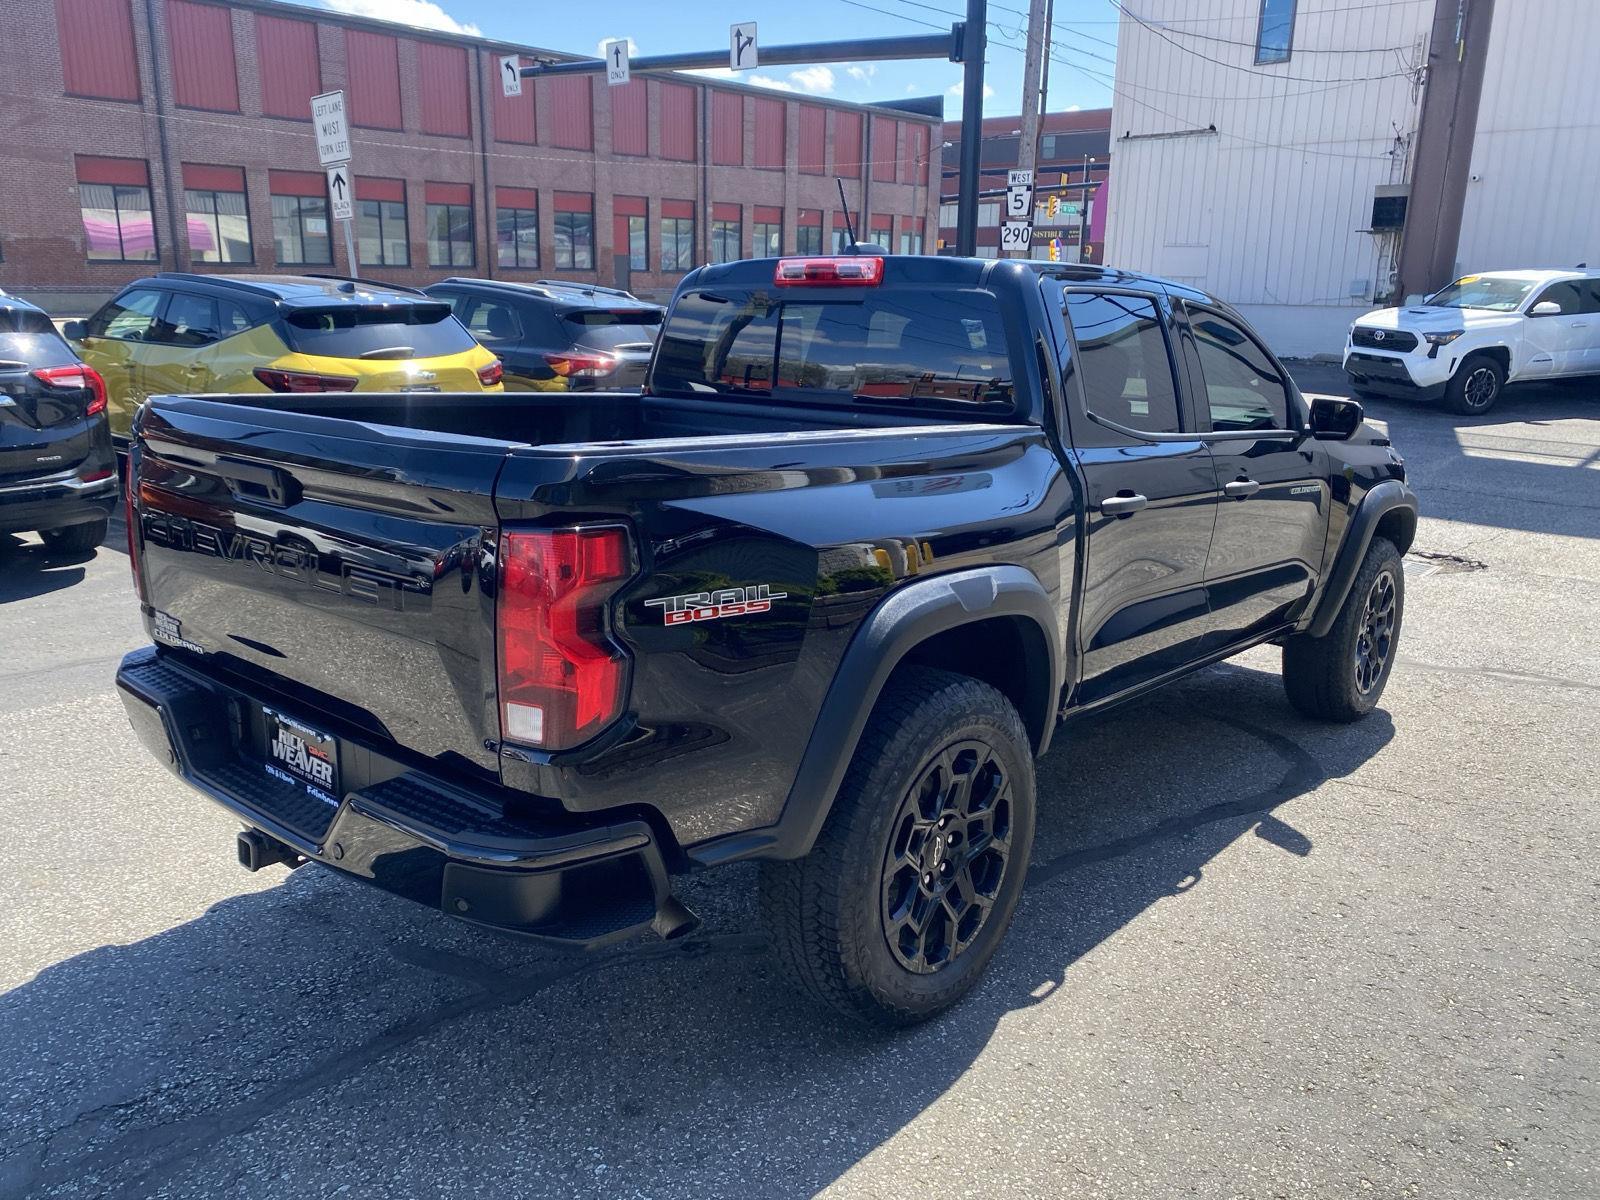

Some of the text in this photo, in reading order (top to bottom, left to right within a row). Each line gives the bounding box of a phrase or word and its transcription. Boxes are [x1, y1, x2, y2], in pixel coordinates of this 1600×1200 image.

[611, 70, 626, 79] ONLY
[505, 84, 519, 92] ONLY
[314, 101, 342, 117] LEFT LANE
[321, 120, 339, 136] MUST
[320, 141, 347, 156] TURN LEFT
[1010, 172, 1030, 182] WEST
[1013, 193, 1024, 210] 5
[1003, 227, 1030, 244] 290
[141, 506, 424, 612] CHEVROLET
[644, 584, 788, 612] TRAIL
[664, 599, 771, 626] BOSS
[154, 628, 204, 655] COLORADO
[278, 728, 305, 751] RICK
[272, 739, 333, 783] WEAVER
